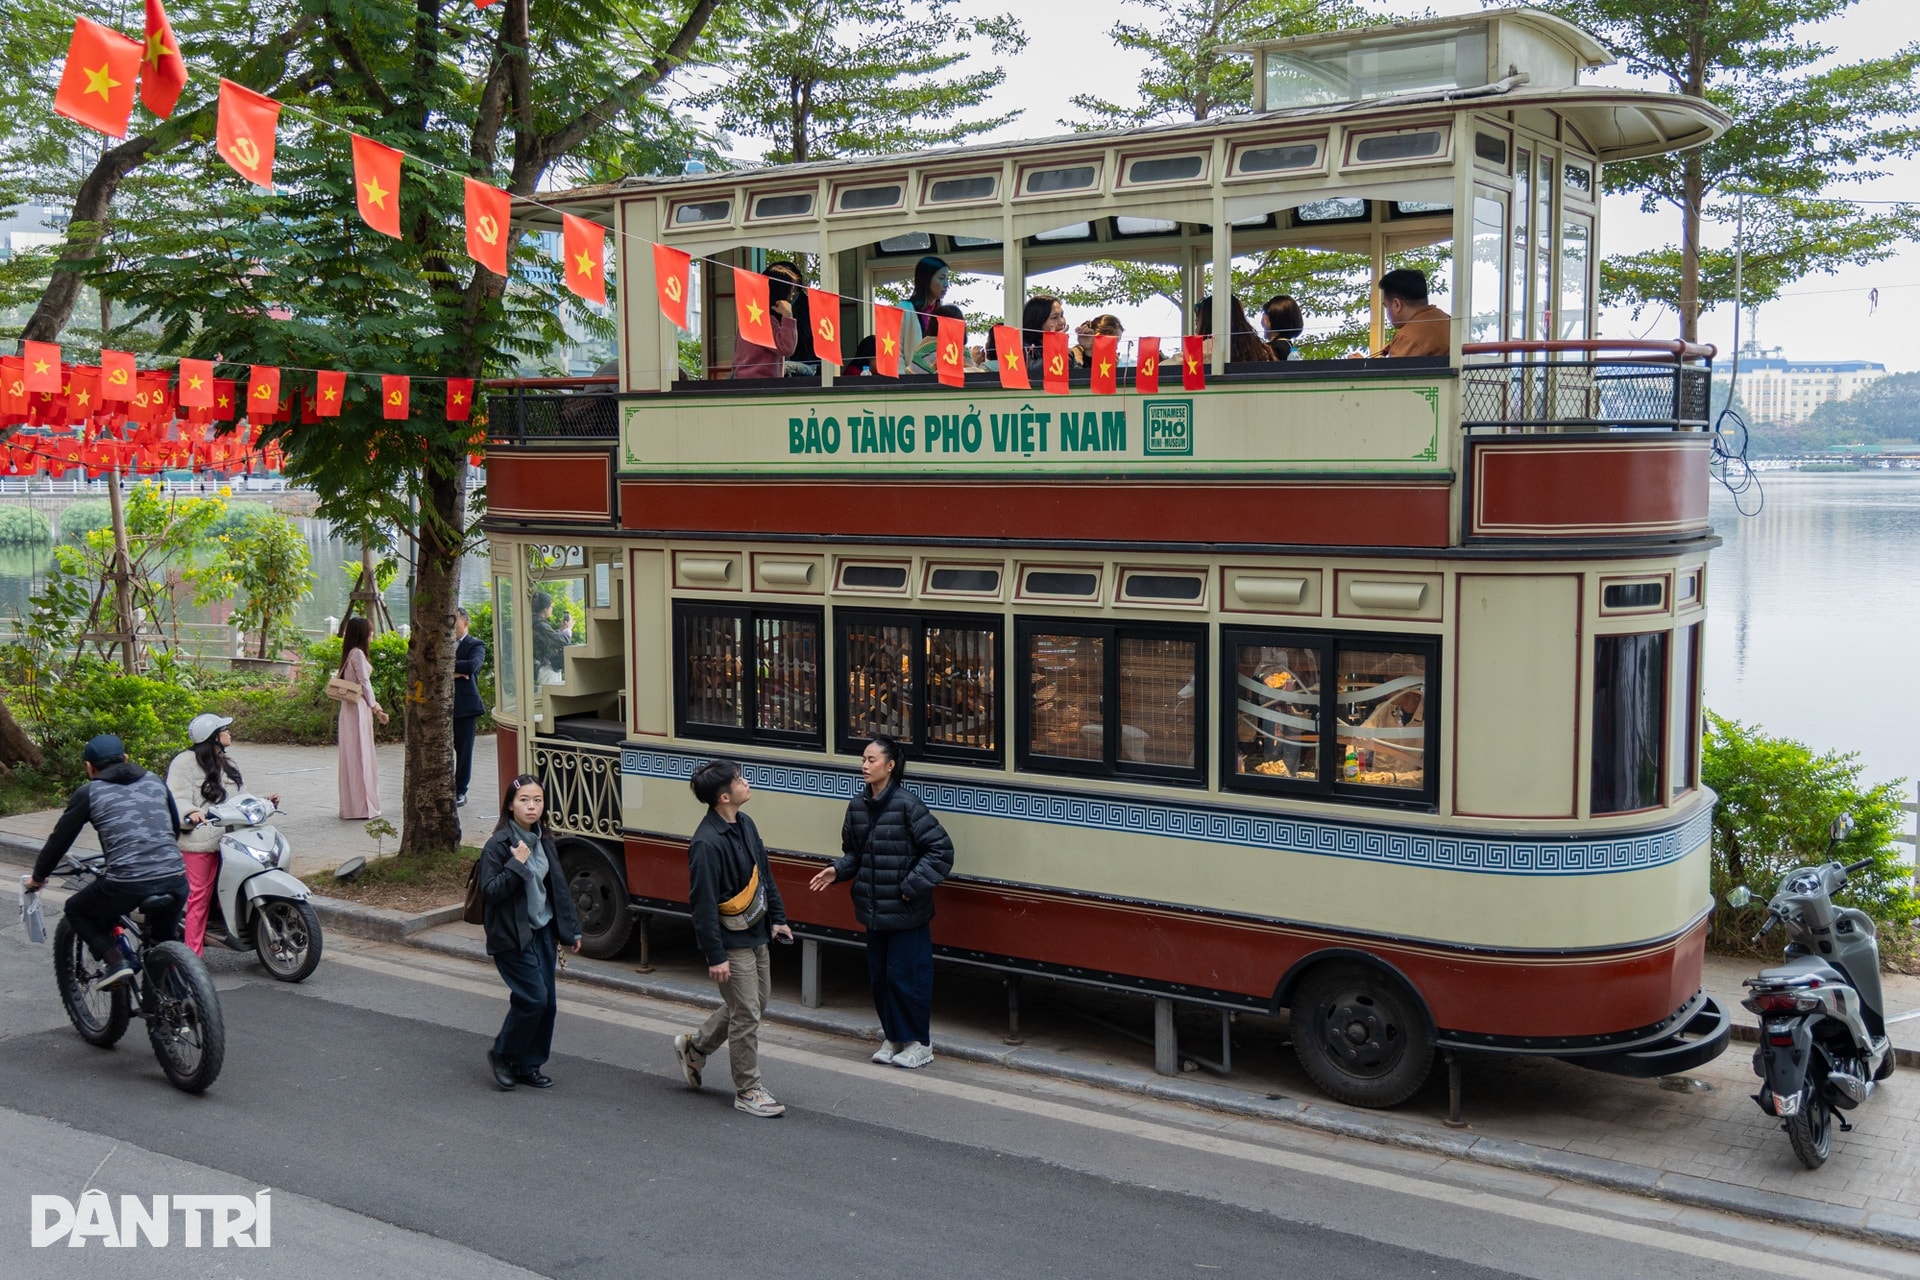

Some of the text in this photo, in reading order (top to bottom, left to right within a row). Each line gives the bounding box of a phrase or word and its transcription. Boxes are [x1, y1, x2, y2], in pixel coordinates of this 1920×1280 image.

[1150, 407, 1186, 418] VIETNAMESE
[788, 404, 1127, 457] BẢO TÀNG PHỞ VIỆT NAM
